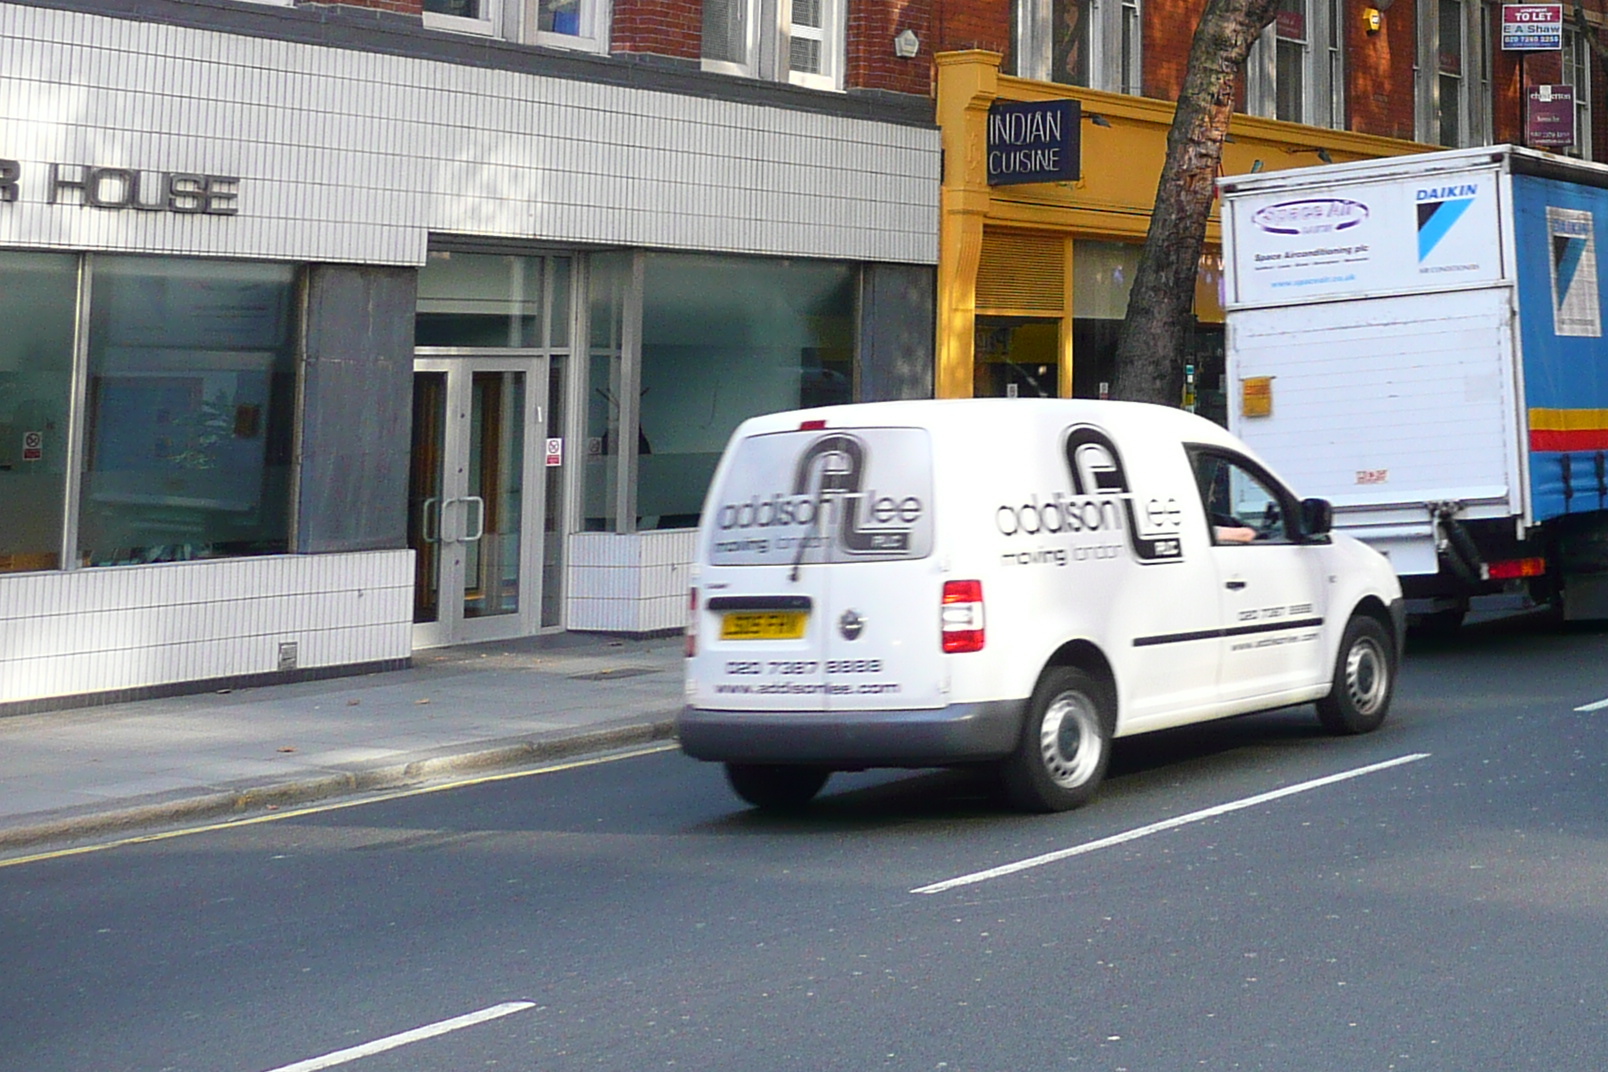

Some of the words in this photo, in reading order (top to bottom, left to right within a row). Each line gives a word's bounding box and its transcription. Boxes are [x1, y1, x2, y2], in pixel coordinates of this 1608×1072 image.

[1515, 13, 1530, 21] TO
[1532, 13, 1552, 21] LET
[1504, 25, 1511, 33] E
[1515, 25, 1524, 33] A
[1527, 24, 1560, 33] Shaw
[990, 110, 1061, 145] INDIAN
[989, 148, 1060, 174] CUISINE
[48, 163, 240, 215] HOUSE
[1417, 184, 1478, 200] DAIKIN
[1254, 253, 1281, 262] Space
[1284, 246, 1352, 259] Airconditioning
[1354, 244, 1369, 253] plc
[717, 492, 840, 530] addison
[866, 490, 922, 524] lee
[997, 491, 1123, 536] addison
[1141, 495, 1181, 527] lee
[716, 536, 770, 554] moving
[1001, 544, 1065, 566] moving
[1239, 610, 1259, 621] 020
[726, 660, 760, 675] 020
[767, 659, 819, 675] 7387
[826, 658, 883, 674] 8888
[715, 680, 902, 695] www.addisonlee.com
